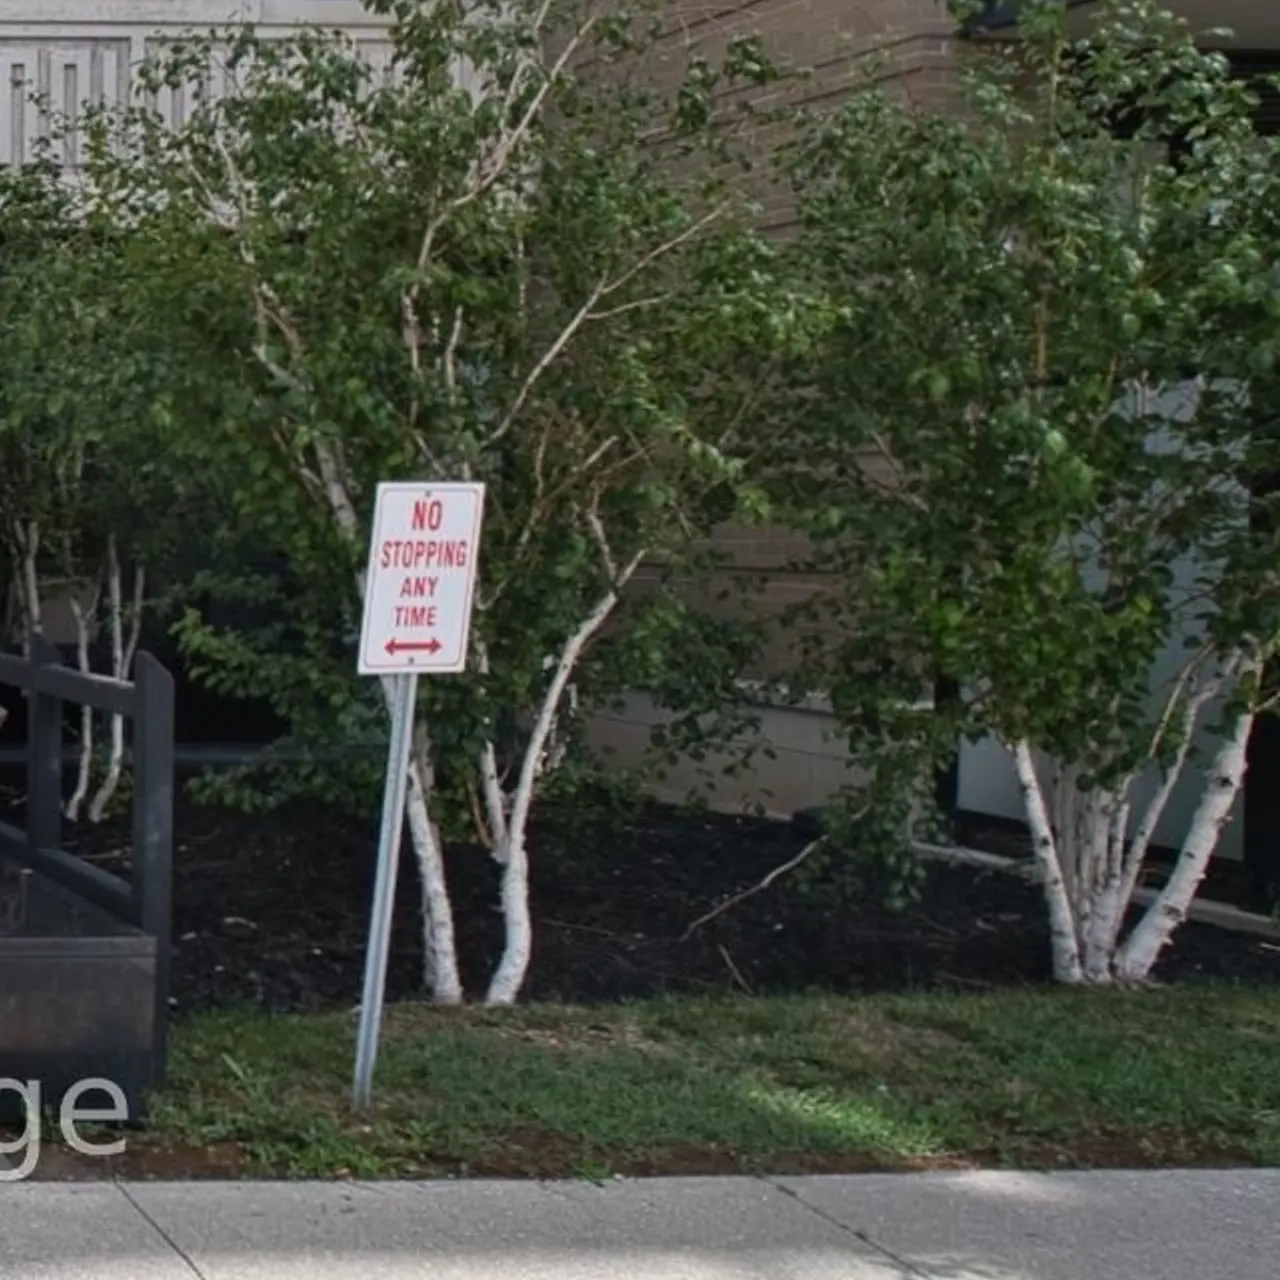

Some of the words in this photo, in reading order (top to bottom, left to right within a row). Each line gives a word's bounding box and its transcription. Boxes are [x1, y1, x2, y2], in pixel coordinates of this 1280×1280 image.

[411, 499, 443, 531] NO
[380, 540, 467, 569] STOPPING
[400, 576, 439, 597] ANY
[394, 606, 438, 627] TIME
